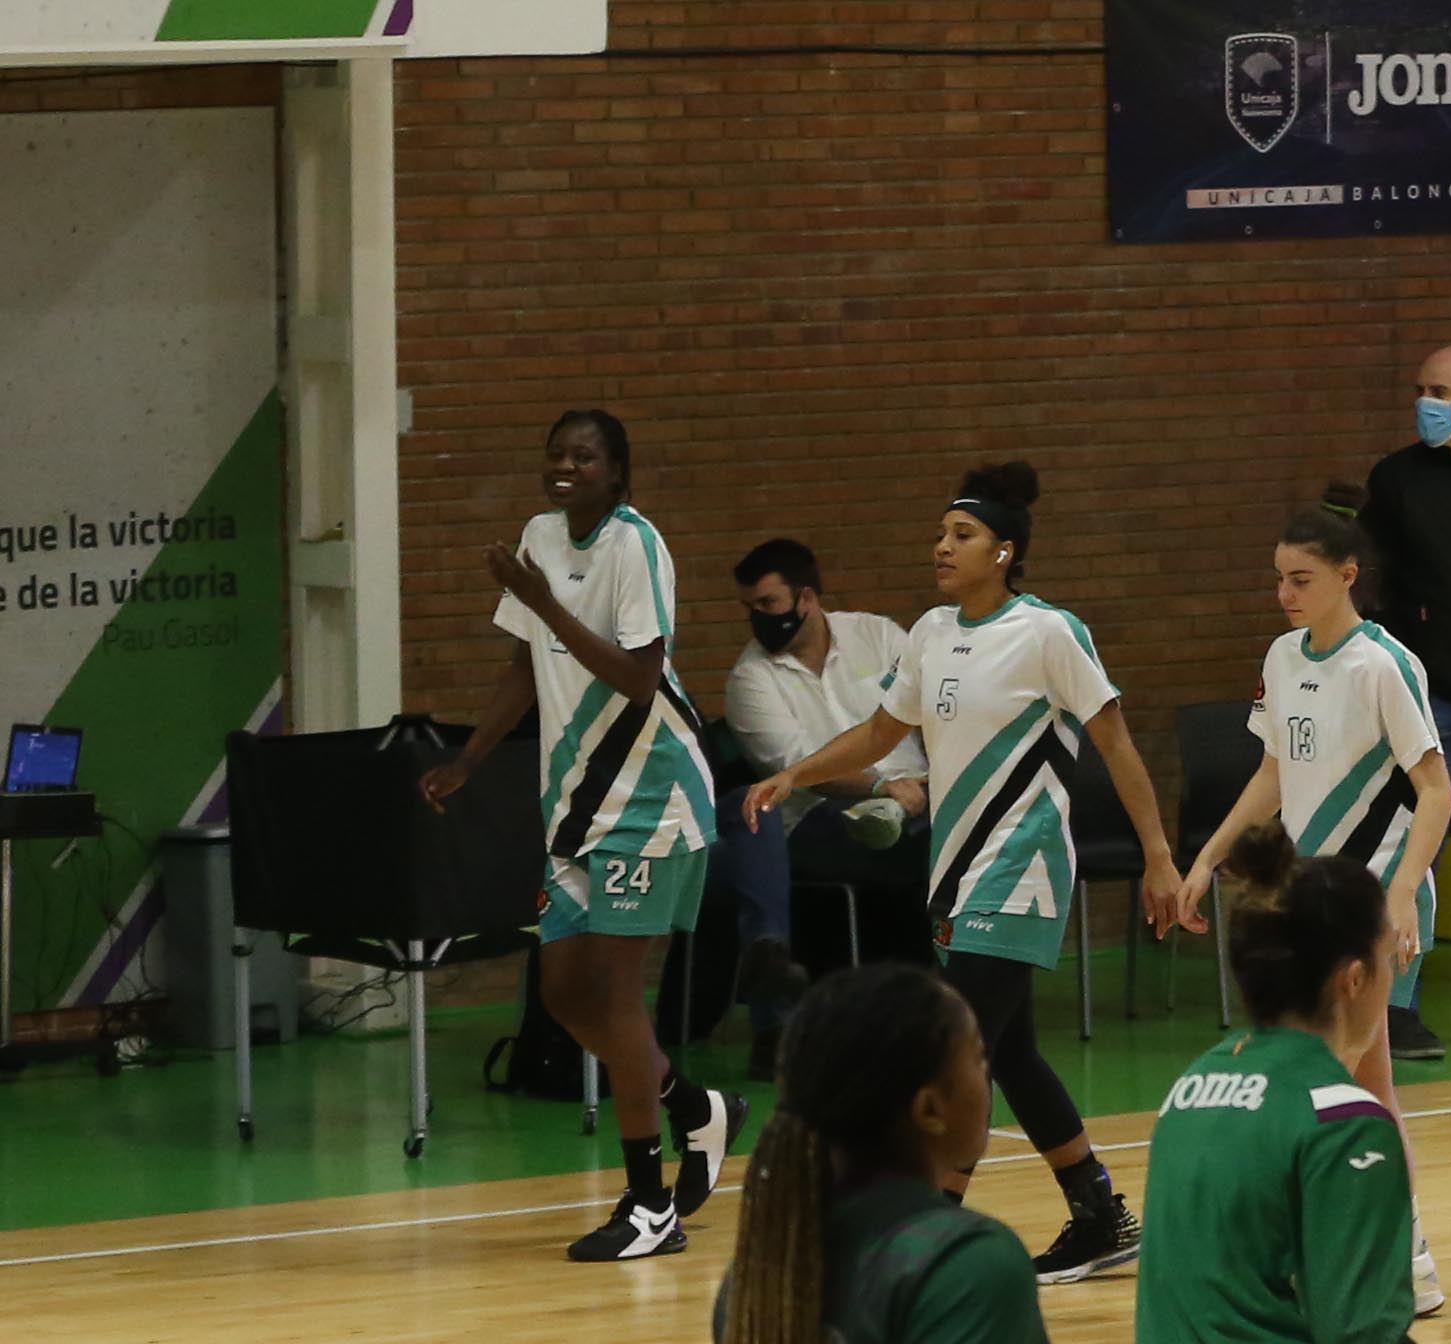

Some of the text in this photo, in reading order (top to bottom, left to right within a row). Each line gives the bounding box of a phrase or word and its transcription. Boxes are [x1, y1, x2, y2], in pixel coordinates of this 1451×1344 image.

[1208, 187, 1332, 206] UNICAJA
[69, 514, 98, 549] la
[109, 508, 237, 547] victoria
[17, 574, 58, 610] de
[70, 572, 99, 606] la
[109, 564, 239, 604] victoria
[104, 614, 240, 653] Pau Gasol
[936, 678, 959, 722] 5
[1287, 716, 1316, 761] 13
[604, 859, 652, 896] 24
